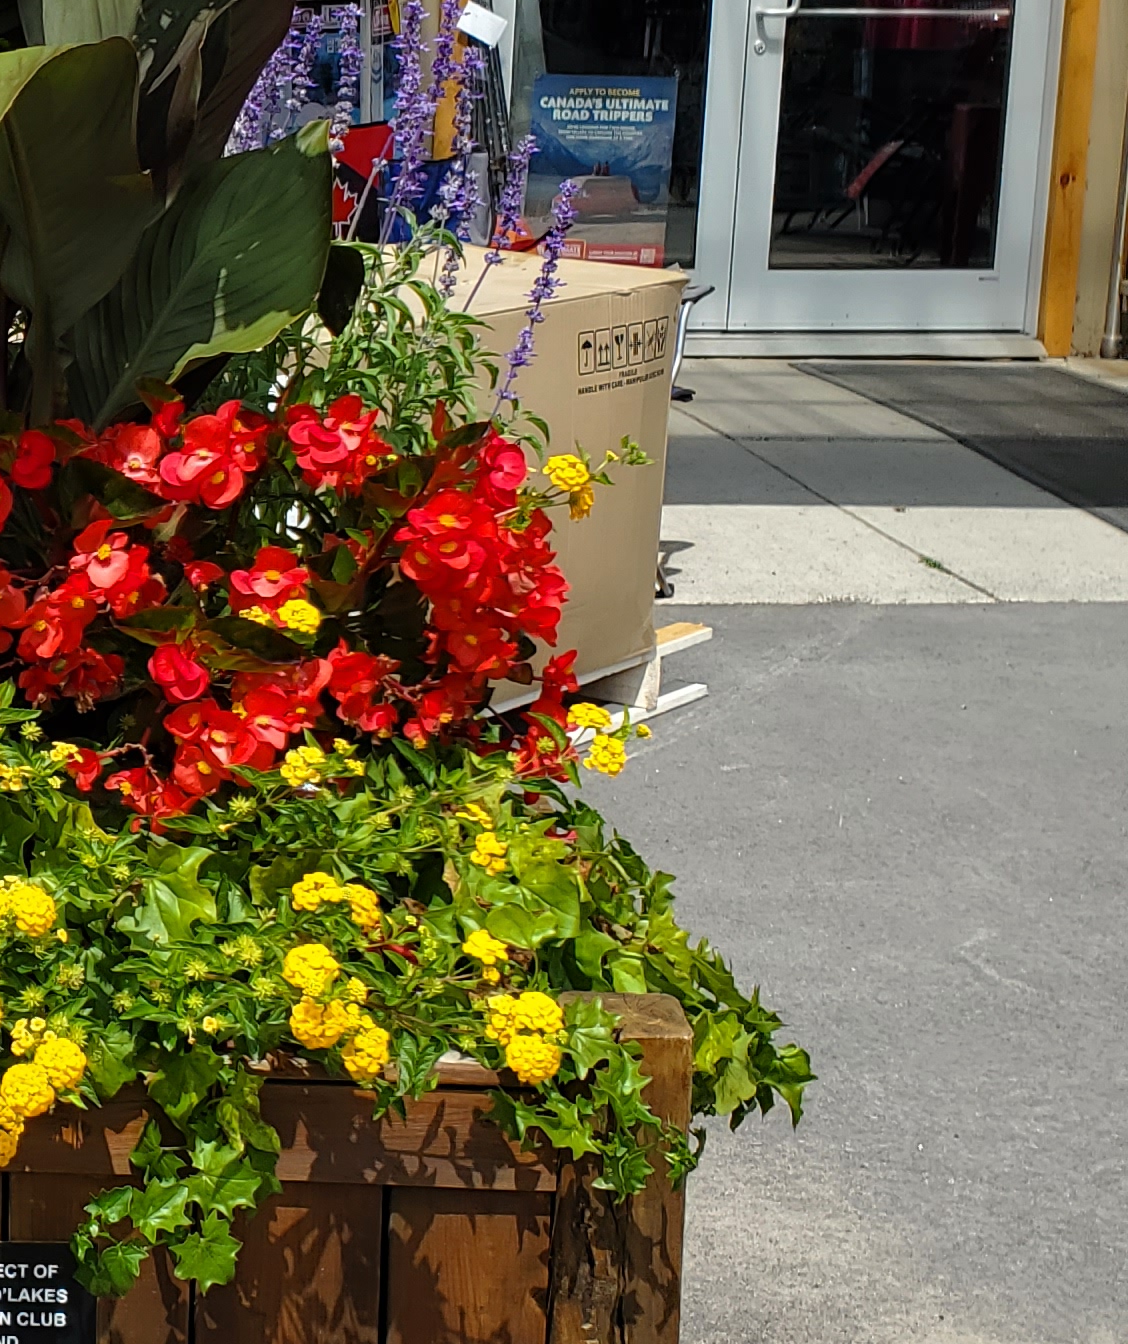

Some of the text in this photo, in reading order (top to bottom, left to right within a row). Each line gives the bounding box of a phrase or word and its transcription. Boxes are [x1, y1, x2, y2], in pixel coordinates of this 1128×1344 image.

[569, 87, 641, 97] APPLY TO BECOME
[540, 96, 669, 112] CANADA'S ULTIMATE
[553, 109, 653, 123] ROAD TRIPPERS
[33, 1264, 60, 1279] OF
[16, 1311, 68, 1327] CLUB
